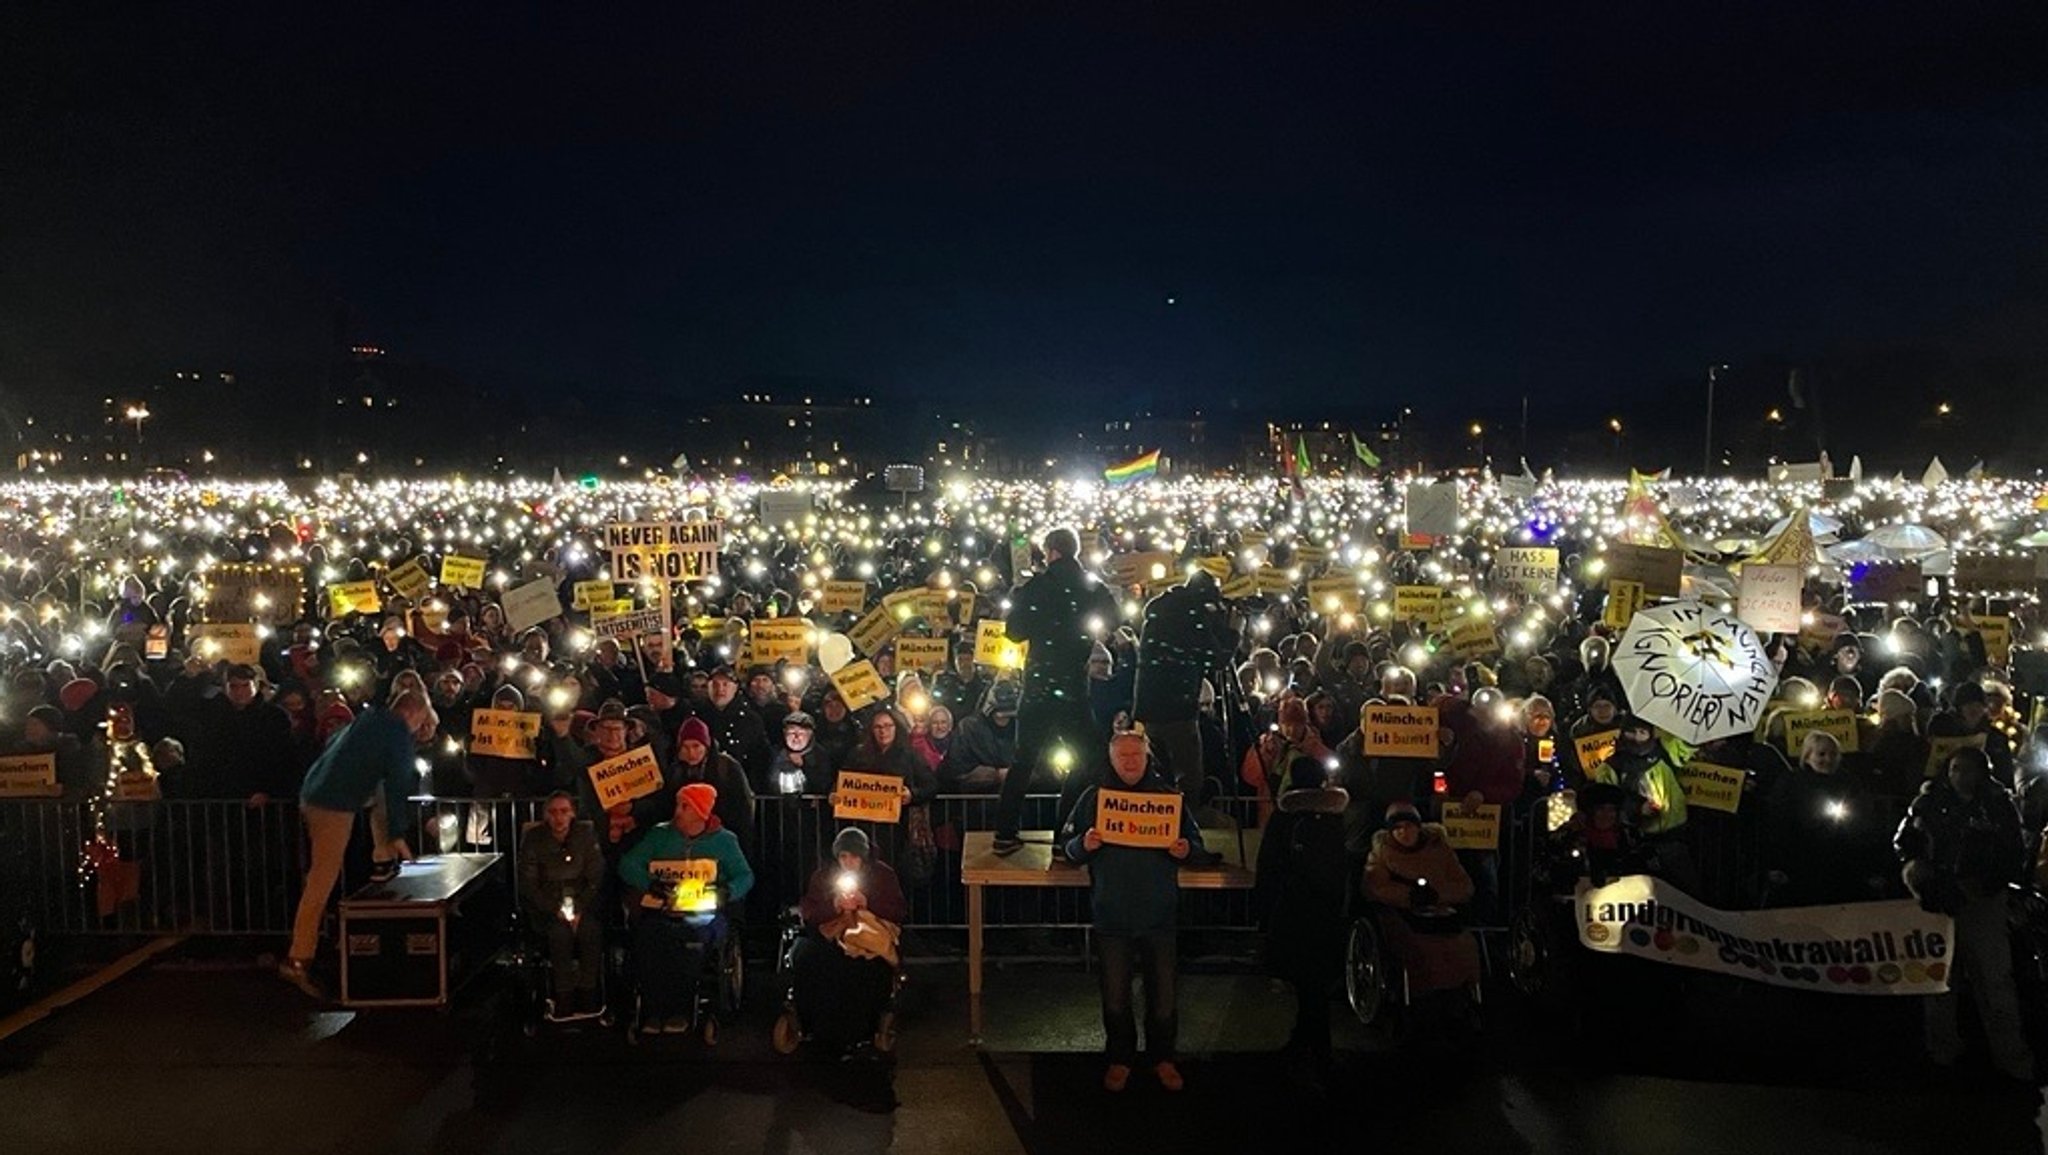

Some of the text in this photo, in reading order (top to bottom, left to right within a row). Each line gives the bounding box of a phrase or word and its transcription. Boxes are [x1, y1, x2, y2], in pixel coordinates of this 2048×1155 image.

[609, 524, 718, 547] NEVER AGAIN
[618, 550, 712, 579] IS NOW!
[1510, 550, 1546, 563] HASS
[1499, 565, 1556, 581] IST KEINE
[826, 583, 863, 595] München
[1672, 607, 1703, 623] IN
[755, 630, 803, 642] München
[901, 640, 945, 654] München
[1371, 712, 1434, 726] München
[1373, 732, 1430, 745] ist bunt!
[595, 754, 651, 782] München
[604, 782, 623, 799] ist
[842, 778, 898, 793] München
[842, 795, 893, 812] ist bunt!
[1104, 797, 1175, 815] München
[1106, 818, 1170, 837] ist bunt!
